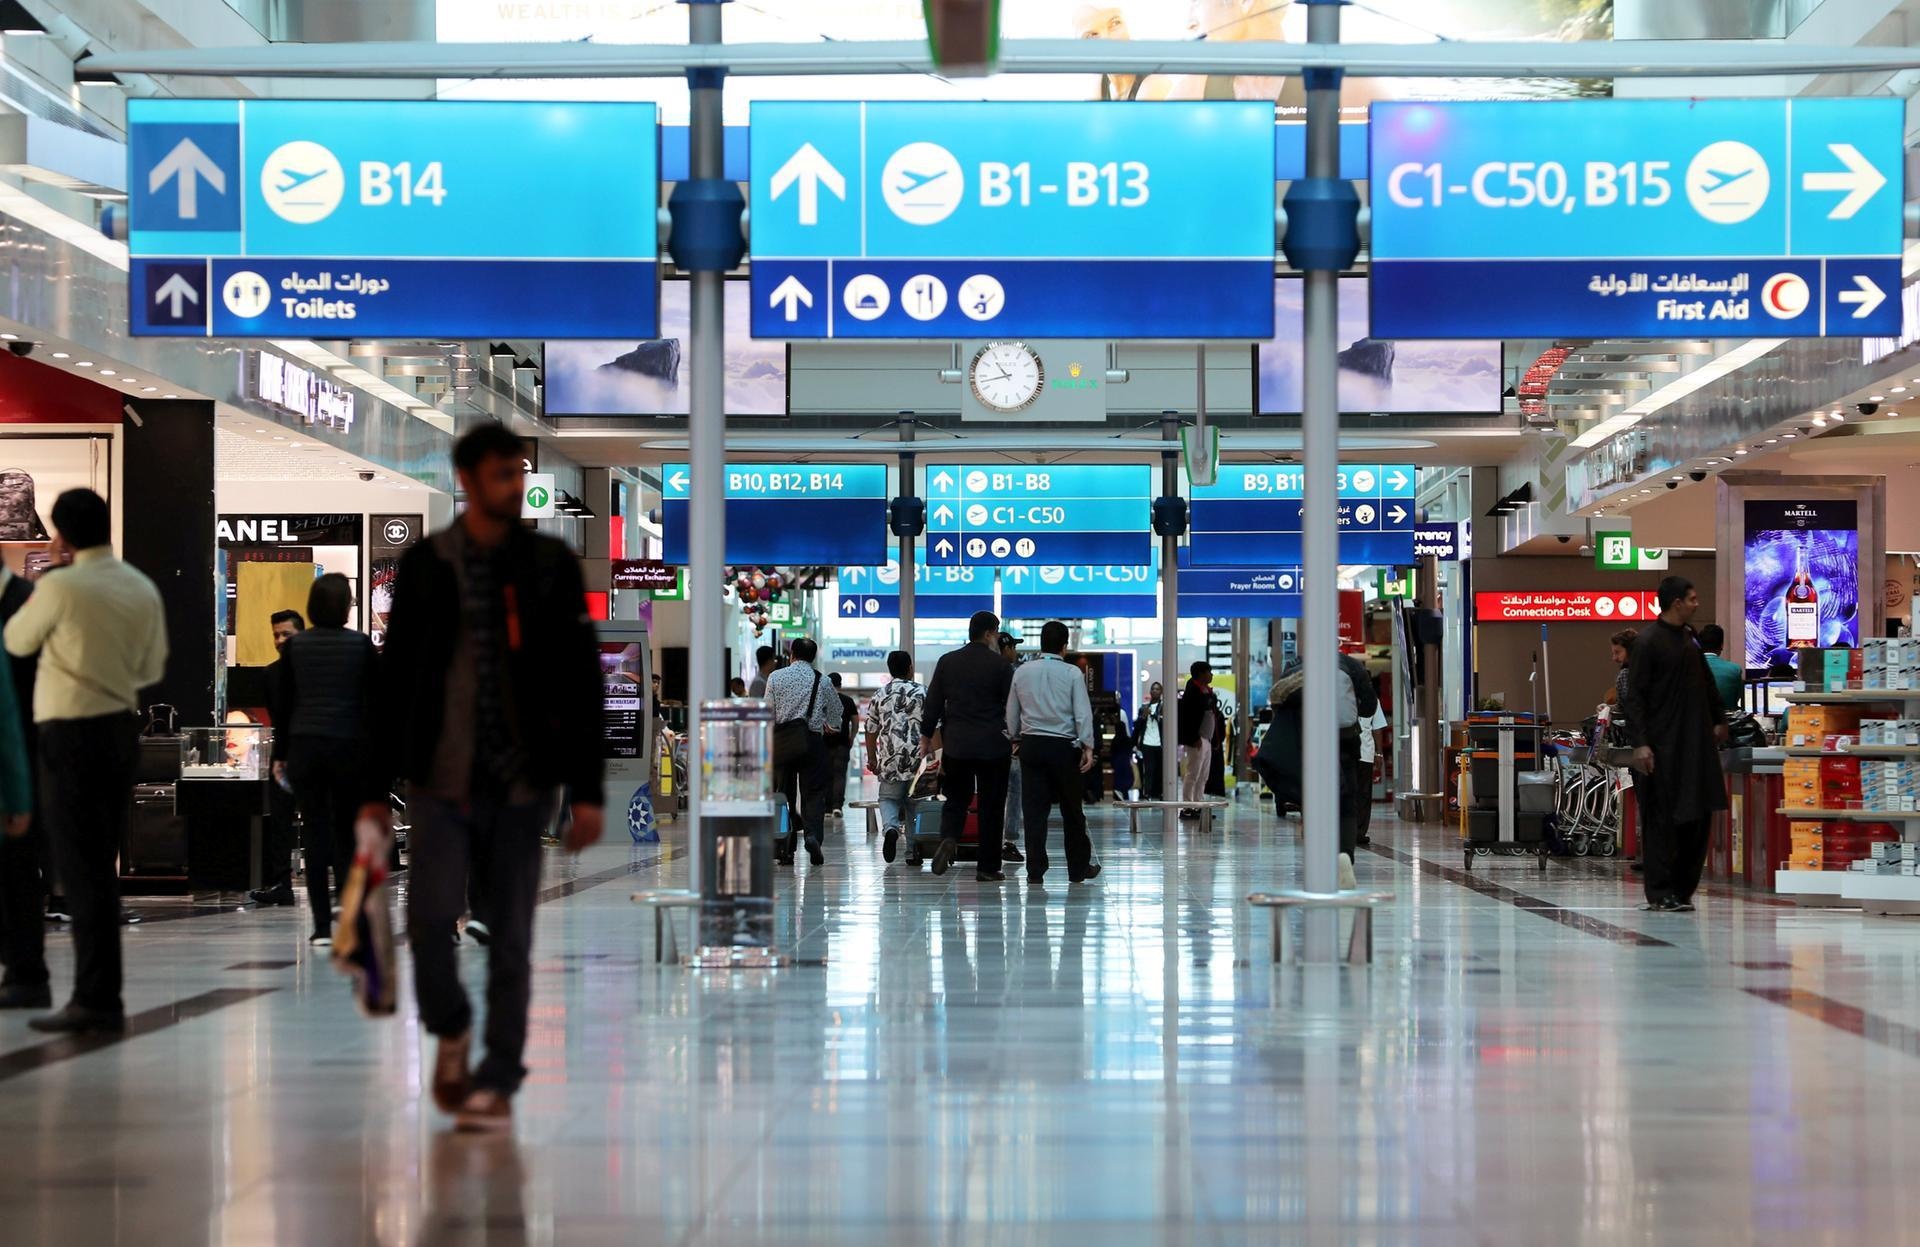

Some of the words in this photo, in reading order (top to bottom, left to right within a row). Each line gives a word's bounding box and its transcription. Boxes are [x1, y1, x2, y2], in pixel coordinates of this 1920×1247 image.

[359, 161, 448, 207] B14
[1585, 161, 1672, 207] B15
[280, 271, 332, 294] المياه
[334, 272, 390, 296] دورات
[282, 297, 357, 320] Toilets
[1656, 298, 1705, 321] First
[1708, 298, 1750, 321] Aid
[729, 473, 767, 493] B10,
[769, 473, 807, 493] B12,
[809, 473, 844, 490] B14
[1243, 473, 1273, 493] B9,
[216, 519, 298, 542] ANEL
[1414, 531, 1452, 543] rrency
[614, 574, 644, 583] Currency
[1230, 582, 1252, 592] Prayer
[1253, 582, 1276, 590] Rooms
[1502, 606, 1565, 618] Connections
[1566, 606, 1592, 618] Desk
[831, 647, 888, 660] pharmacy
